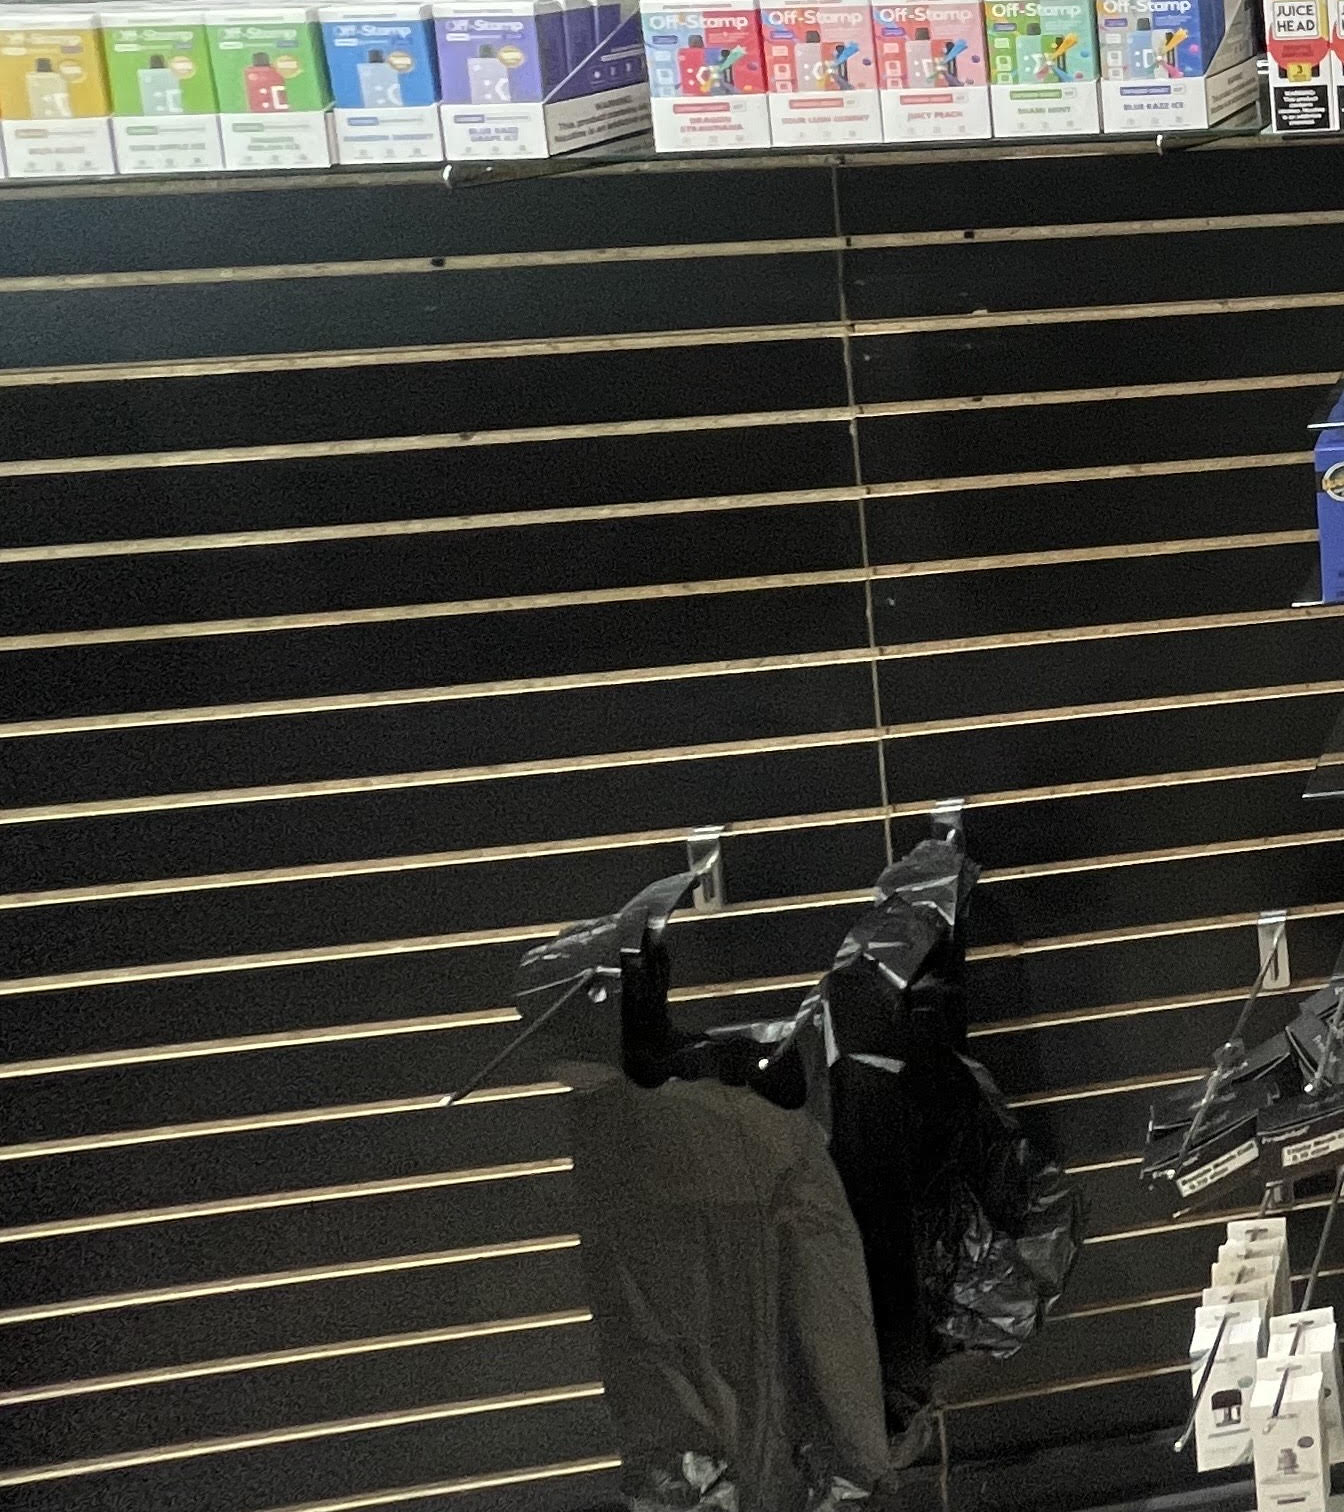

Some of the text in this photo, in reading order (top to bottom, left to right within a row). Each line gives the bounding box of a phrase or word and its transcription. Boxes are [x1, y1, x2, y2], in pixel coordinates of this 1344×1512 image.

[767, 10, 863, 26] Off-Stamp
[879, 7, 973, 23] Off-Stamp
[1277, 5, 1315, 16] JUICE
[649, 15, 749, 31] Off-Stamp
[1277, 19, 1315, 33] HEAD
